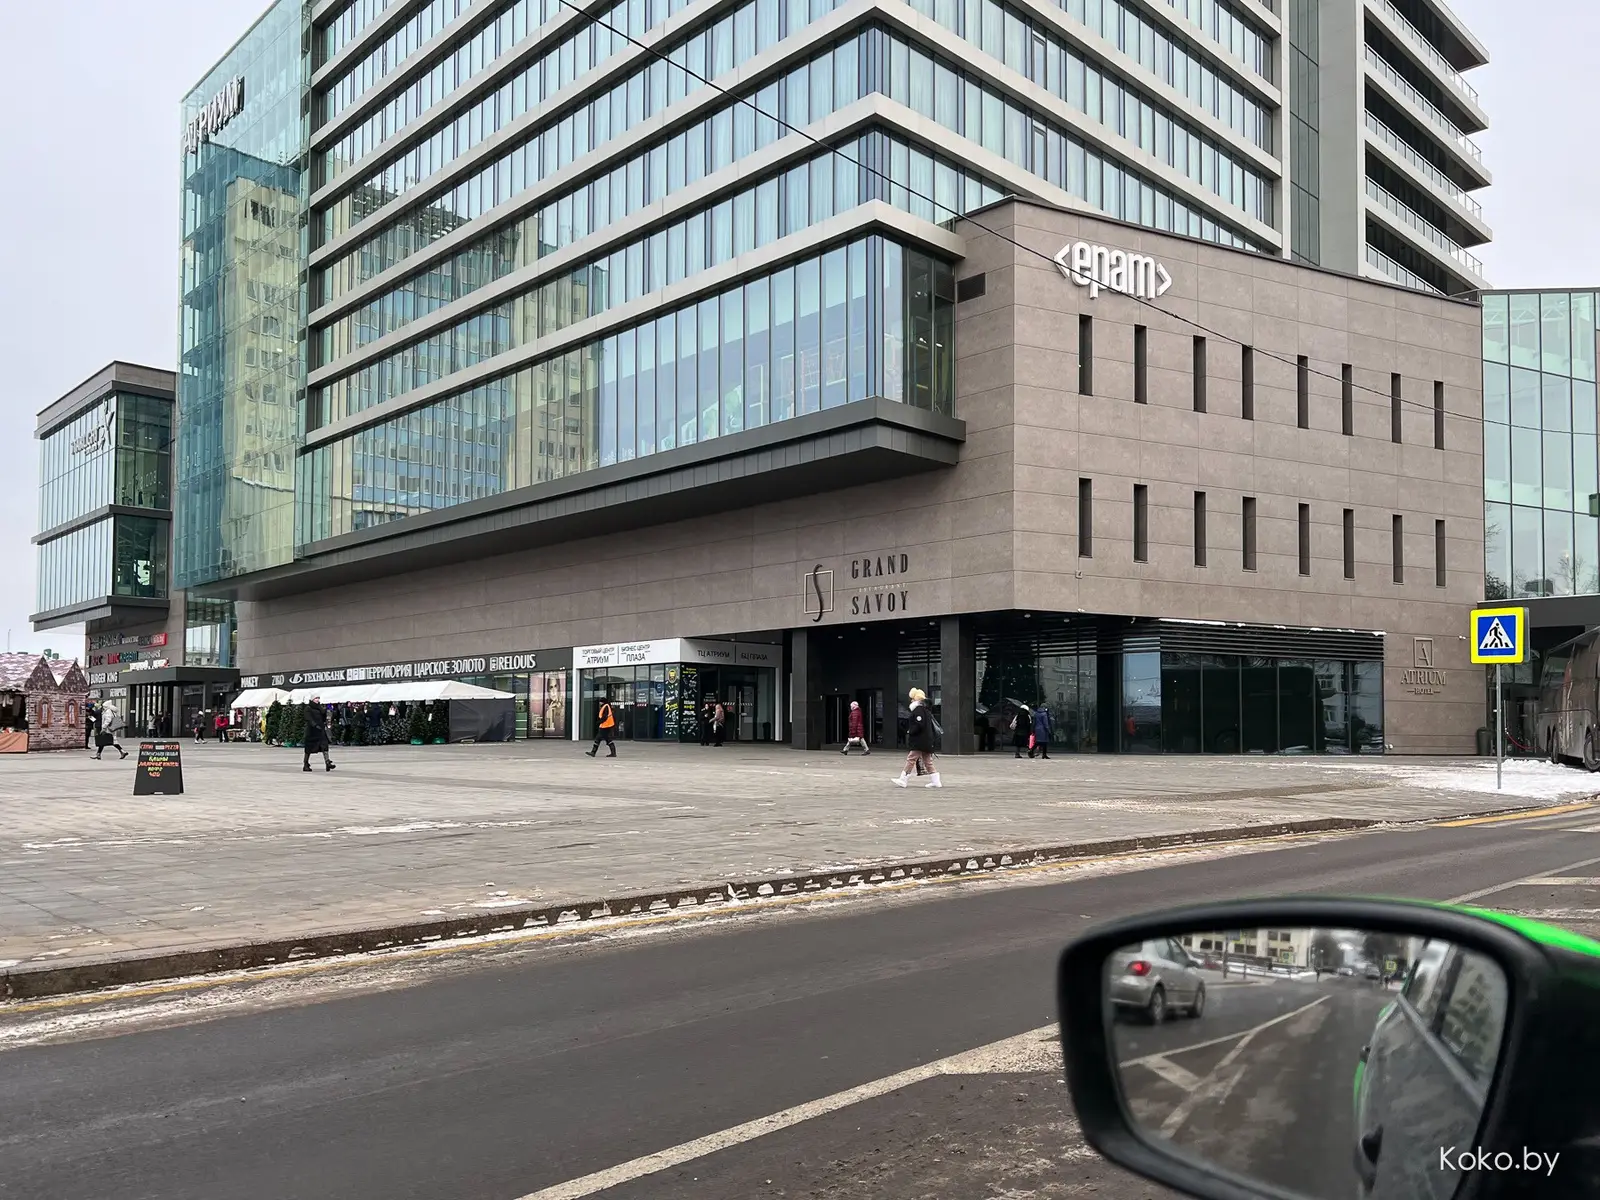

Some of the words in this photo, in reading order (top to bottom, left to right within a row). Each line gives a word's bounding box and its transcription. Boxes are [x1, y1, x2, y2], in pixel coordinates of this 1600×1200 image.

[851, 553, 908, 580] GRAND
[851, 590, 909, 616] SAVOY
[498, 653, 536, 671] RELOUIS
[586, 655, 609, 665] АТРИУМ
[626, 653, 646, 663] ПЛАЗА
[706, 650, 730, 659] АТРИУМ
[303, 669, 346, 683] ТЕХНОБАНК
[414, 661, 450, 678] ЦАРСКОЕ
[451, 658, 486, 674] ЗОЛОТО
[1400, 669, 1447, 686] ATRIUM
